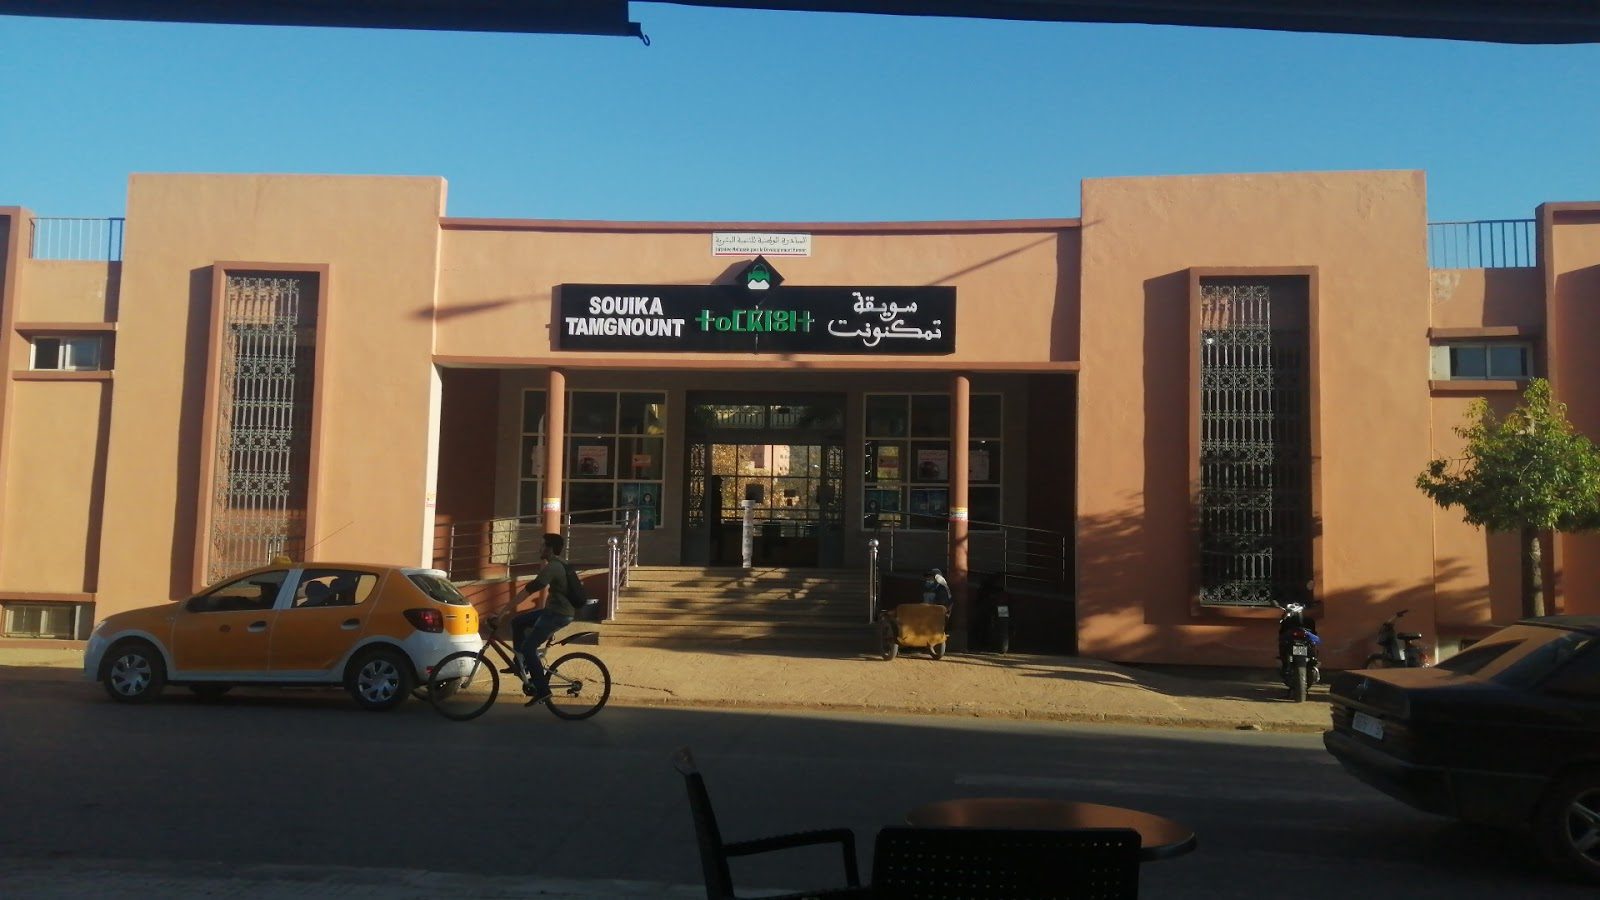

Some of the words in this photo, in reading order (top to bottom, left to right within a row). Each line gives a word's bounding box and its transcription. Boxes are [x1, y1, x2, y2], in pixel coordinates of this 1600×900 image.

[589, 297, 664, 316] SOUIKA
[852, 292, 918, 321] سويقة
[566, 317, 685, 337] TAMGNOUNT
[828, 320, 942, 347] تمكنونت
